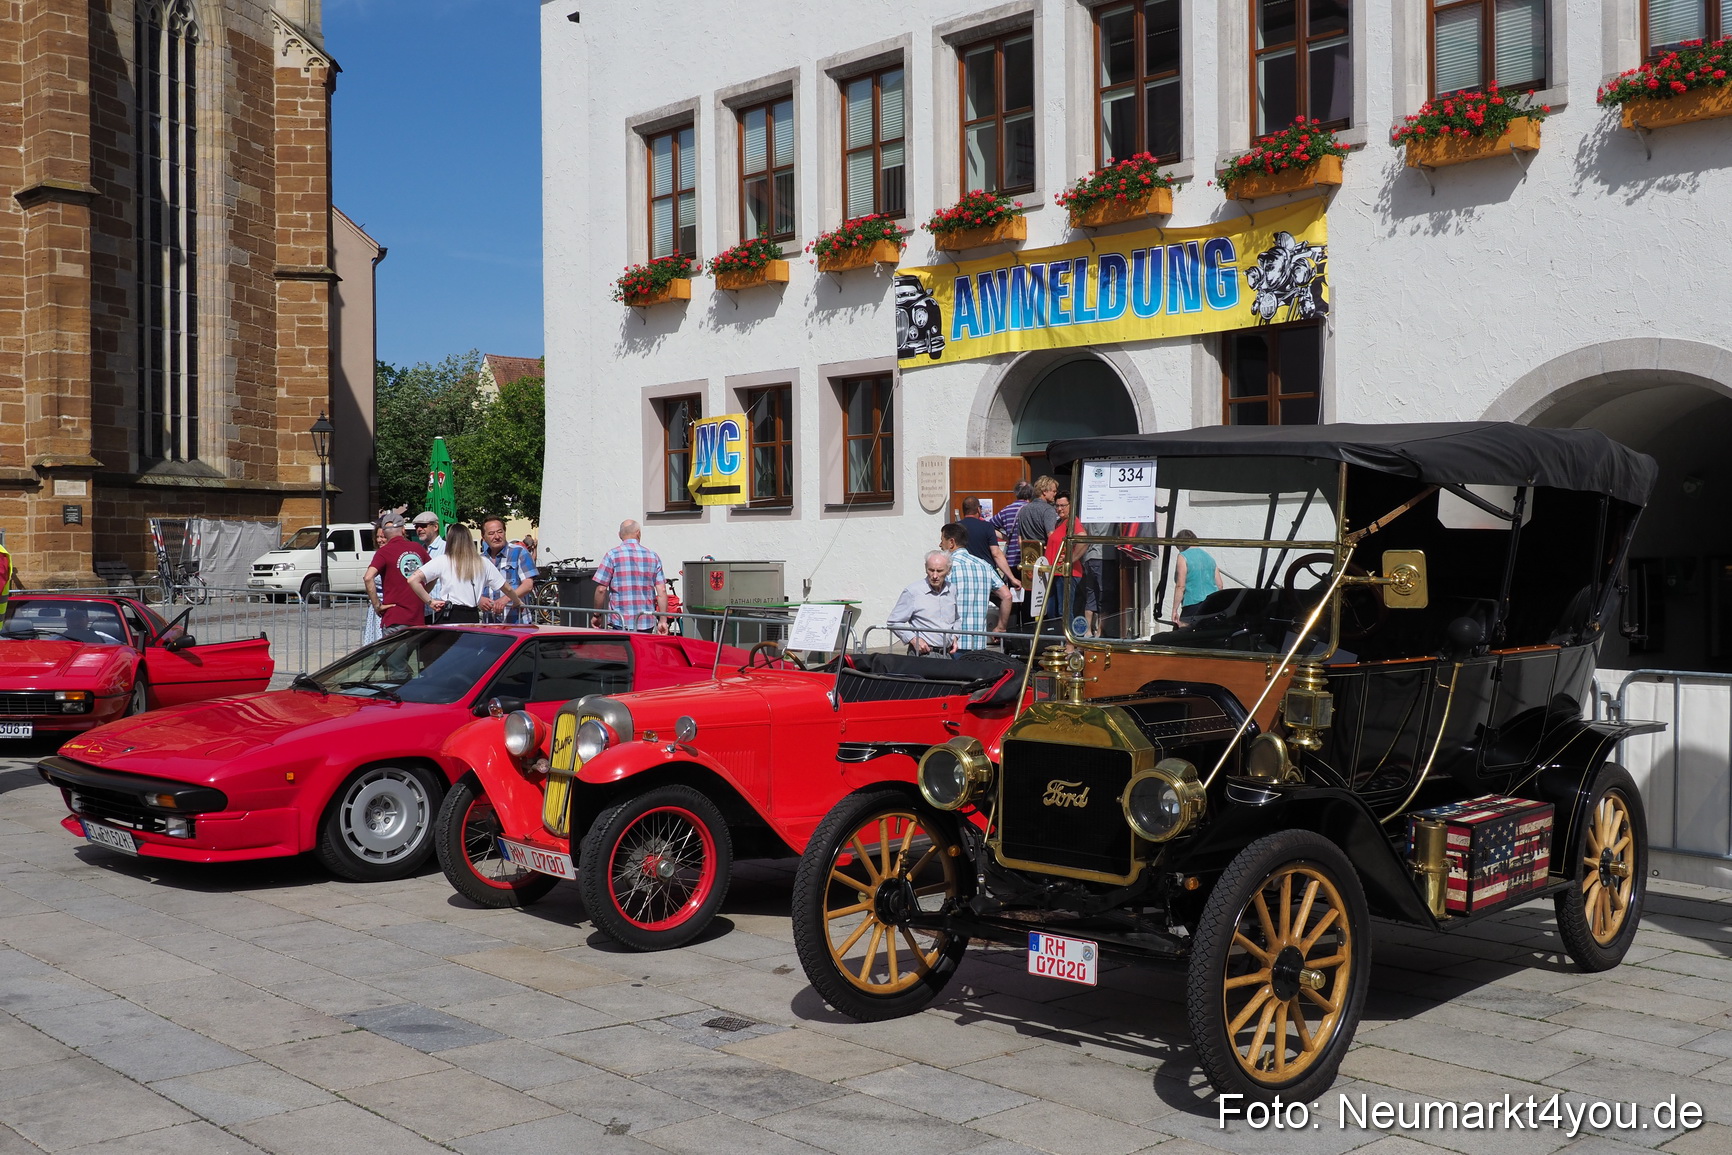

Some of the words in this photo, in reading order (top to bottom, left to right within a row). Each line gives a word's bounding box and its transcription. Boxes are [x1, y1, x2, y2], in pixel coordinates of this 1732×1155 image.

[950, 236, 1240, 342] ANMELDUNG
[694, 419, 741, 478] WC
[1118, 468, 1143, 482] 334
[1042, 780, 1090, 808] Ford
[508, 844, 528, 865] NM
[531, 850, 566, 875] 0700
[1045, 937, 1066, 958] RH
[1036, 955, 1086, 981] 07020
